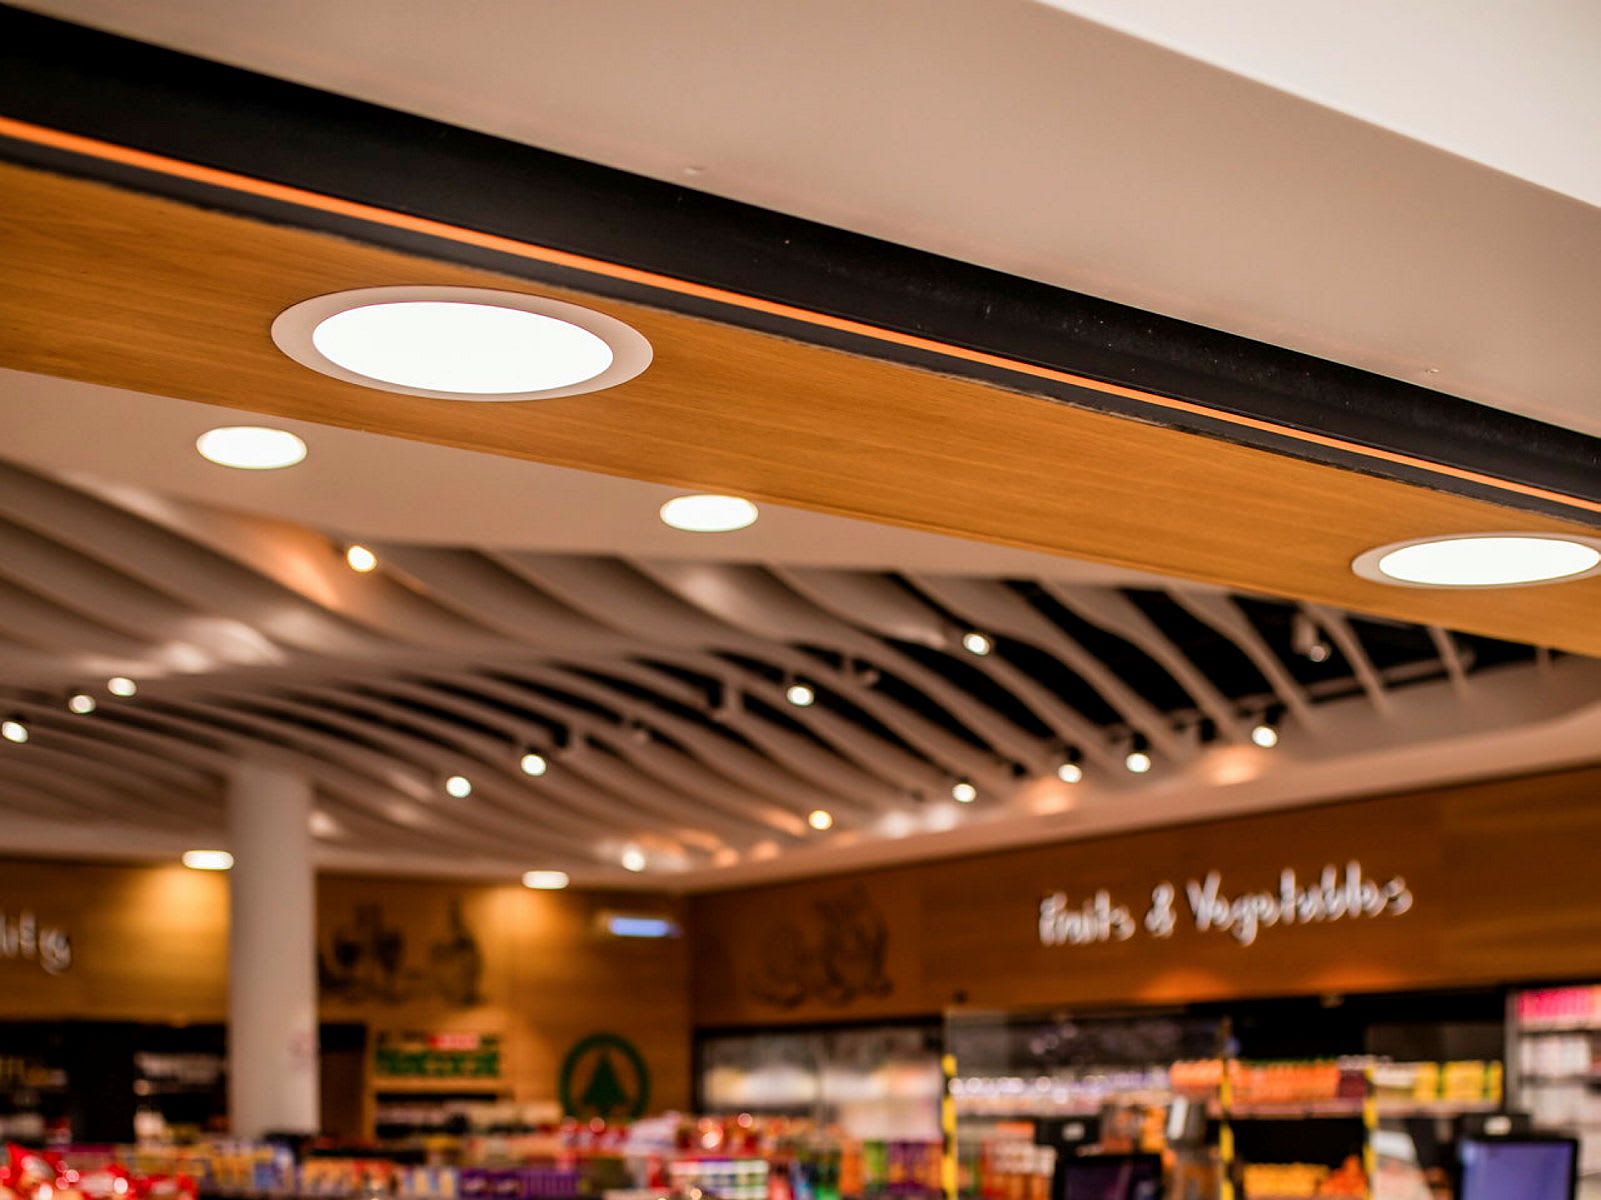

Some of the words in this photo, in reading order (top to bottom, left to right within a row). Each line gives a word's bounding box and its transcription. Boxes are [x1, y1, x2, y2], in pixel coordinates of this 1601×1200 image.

[1039, 889, 1136, 945] Fruits
[1144, 880, 1177, 938] &
[1186, 859, 1413, 947] Vegetables
